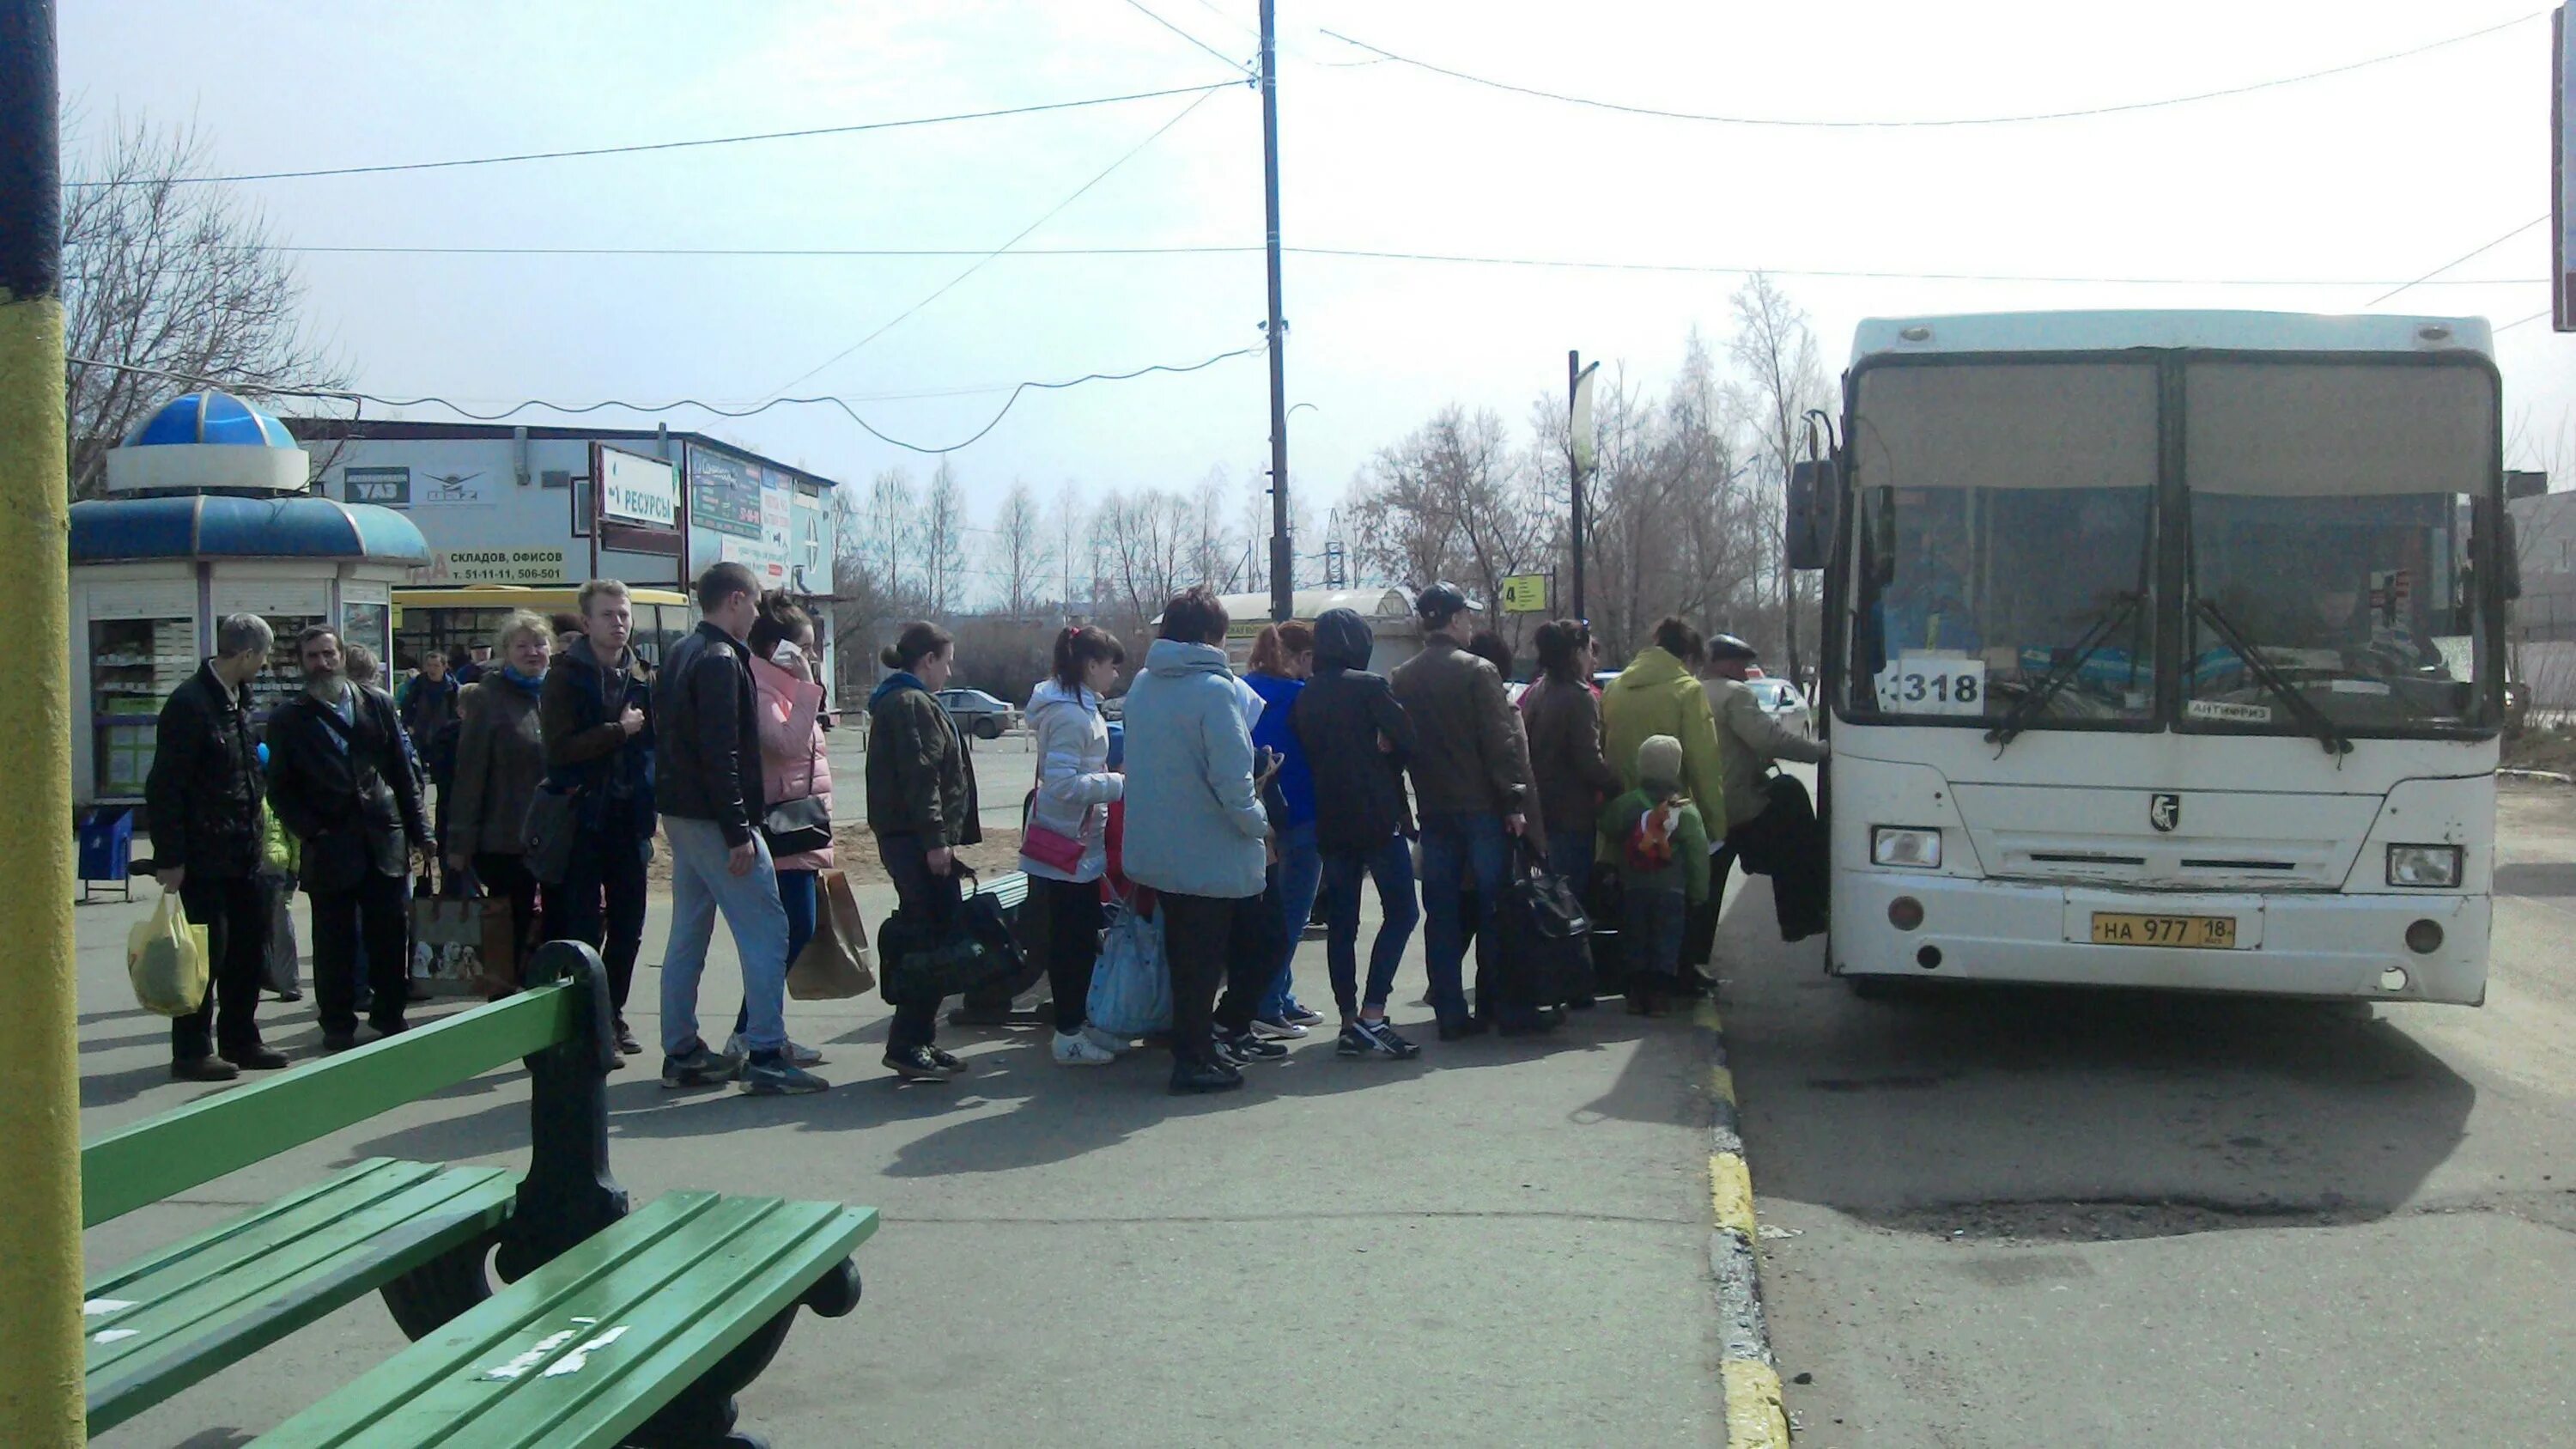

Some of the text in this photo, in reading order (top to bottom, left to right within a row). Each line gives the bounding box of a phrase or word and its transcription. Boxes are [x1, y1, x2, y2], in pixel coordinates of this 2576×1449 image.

[624, 489, 671, 520] РЕСУРСЫ
[451, 552, 562, 563] СКЛАДОВ, ОФИСОВ
[518, 569, 560, 579] 506-501
[1506, 587, 1516, 602] 4
[1905, 673, 1978, 703] 318
[2193, 703, 2265, 719] АНТИФРИЗ
[2105, 919, 2226, 942] НА 977 18
